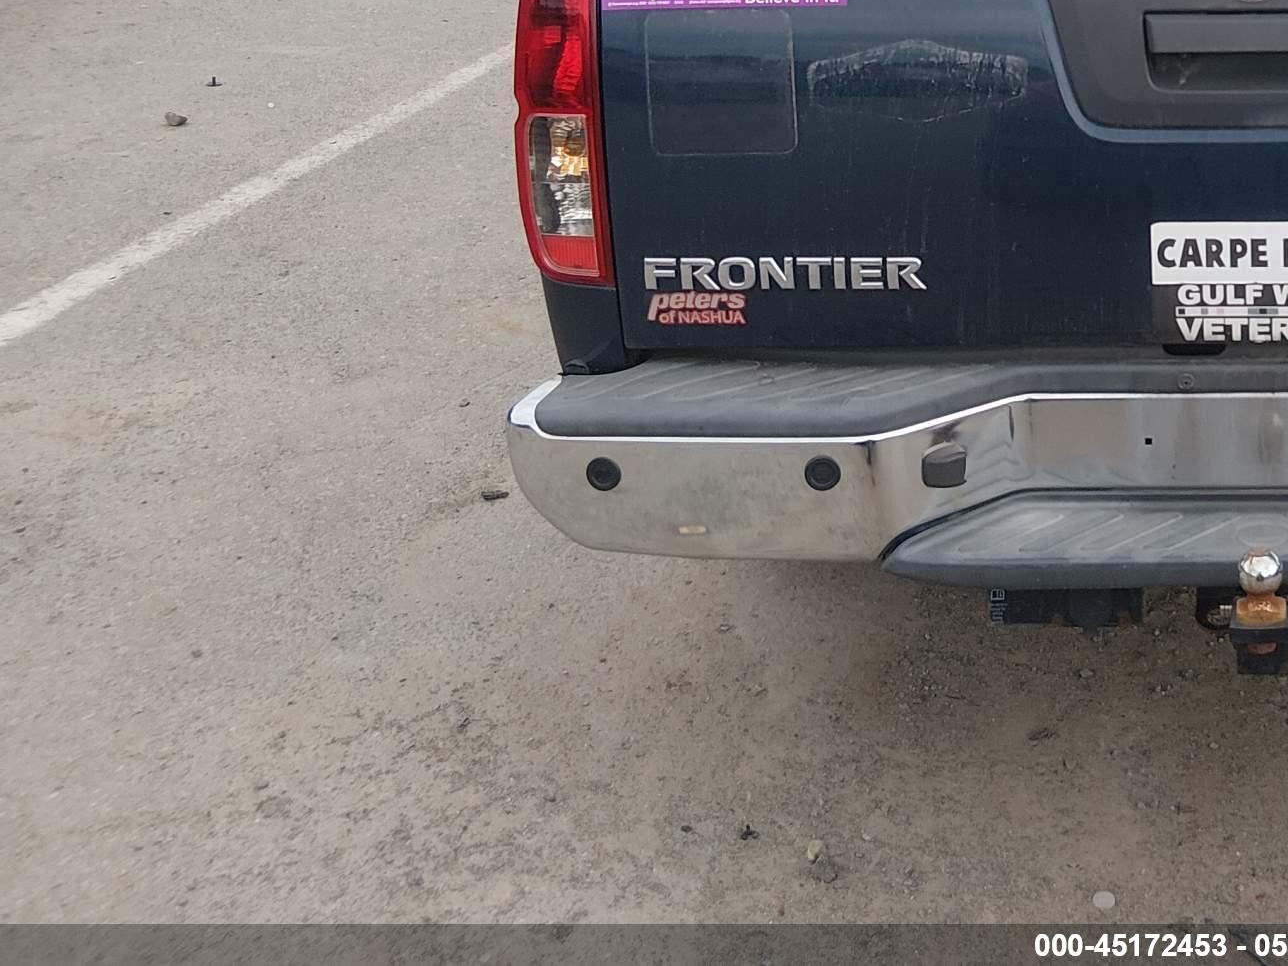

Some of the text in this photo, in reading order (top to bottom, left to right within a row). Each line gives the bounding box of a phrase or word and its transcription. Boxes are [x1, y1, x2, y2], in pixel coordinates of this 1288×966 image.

[1157, 237, 1269, 269] CARPE
[643, 256, 928, 291] FRONTIER
[1177, 284, 1264, 306] GULF
[658, 310, 747, 324] of NASHUA
